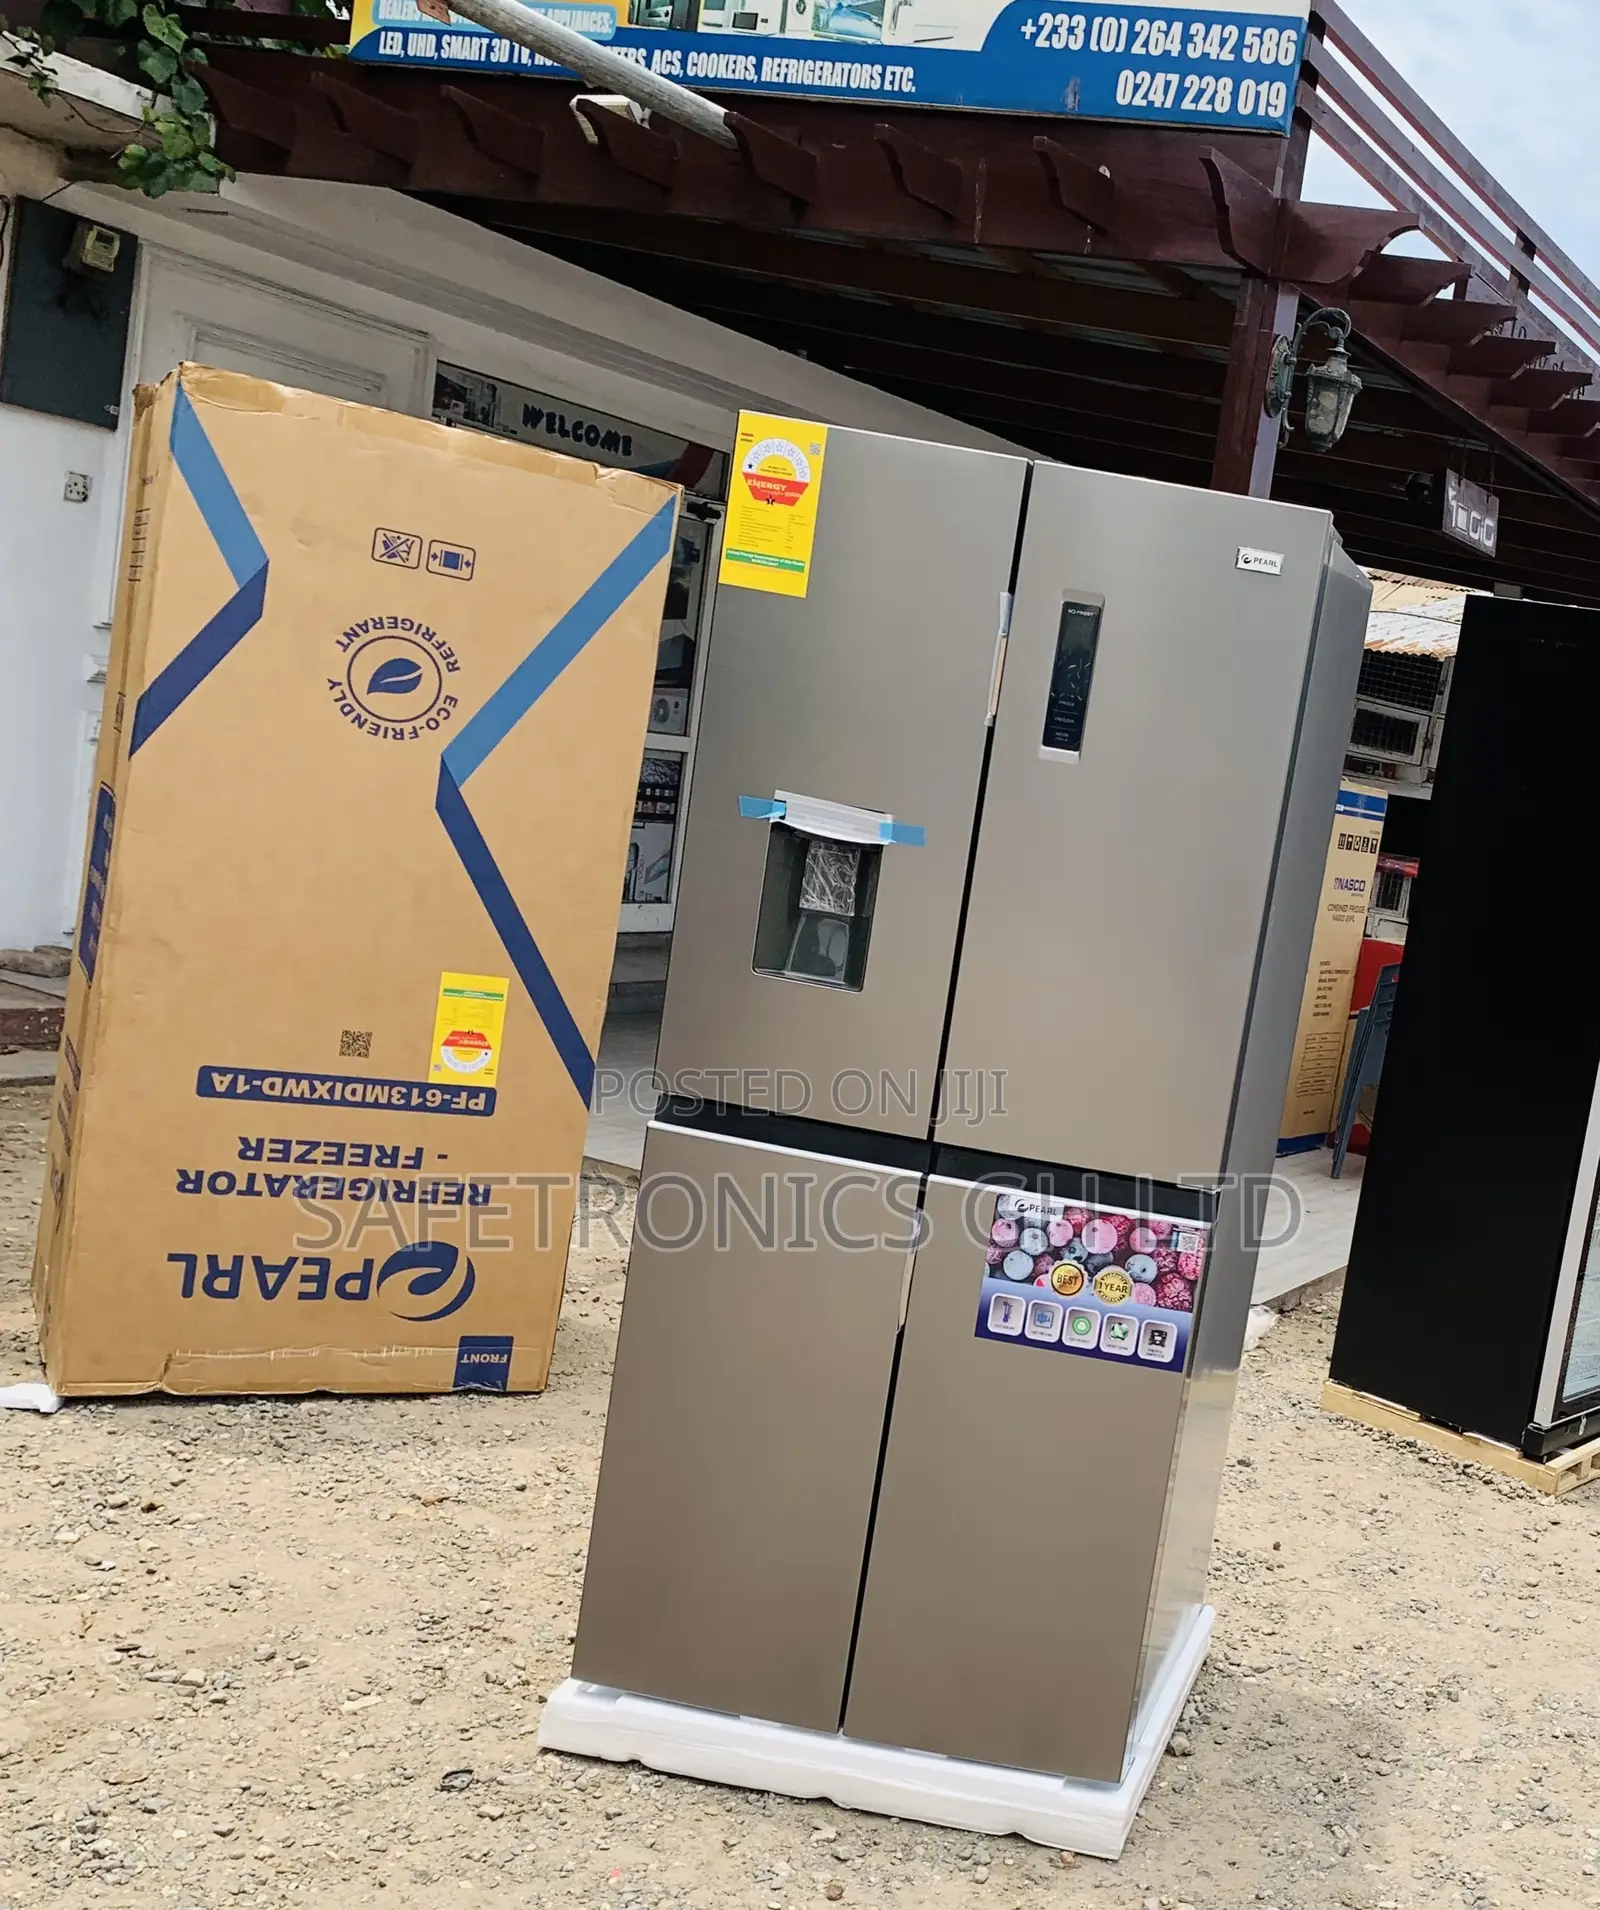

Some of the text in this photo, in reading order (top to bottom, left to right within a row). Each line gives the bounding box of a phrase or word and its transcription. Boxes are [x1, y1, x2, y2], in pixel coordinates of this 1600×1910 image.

[379, 31, 403, 58] LED,
[407, 32, 438, 60] UHD,
[441, 34, 489, 61] SMART
[491, 37, 510, 63] 3D
[512, 41, 531, 67] TV,
[1020, 12, 1298, 66] +233 (0) 264 342 586
[651, 49, 684, 78] ACS,
[686, 51, 758, 83] COOKERS,
[760, 56, 882, 90] REFRIGERATORS
[883, 65, 916, 93] ETC.
[1116, 69, 1287, 118] 0247 228 019
[522, 403, 633, 457] WELCOME
[747, 479, 787, 492] ENERGY
[1253, 556, 1279, 569] PEARL
[335, 616, 461, 673] REFRIGERANT
[327, 677, 458, 741] ECO-FRIENDLY
[1337, 877, 1366, 892] NASCO
[210, 1071, 487, 1112] PF-613MDIXWD-1A
[237, 1136, 425, 1170] FREEZER
[176, 1169, 492, 1206] REFRIGERATOR
[1028, 1203, 1057, 1216] PEARL
[167, 1252, 375, 1300] PEARL
[1056, 1273, 1079, 1287] BEST
[1104, 1282, 1128, 1294] YEAR
[460, 1352, 508, 1365] FRONT
